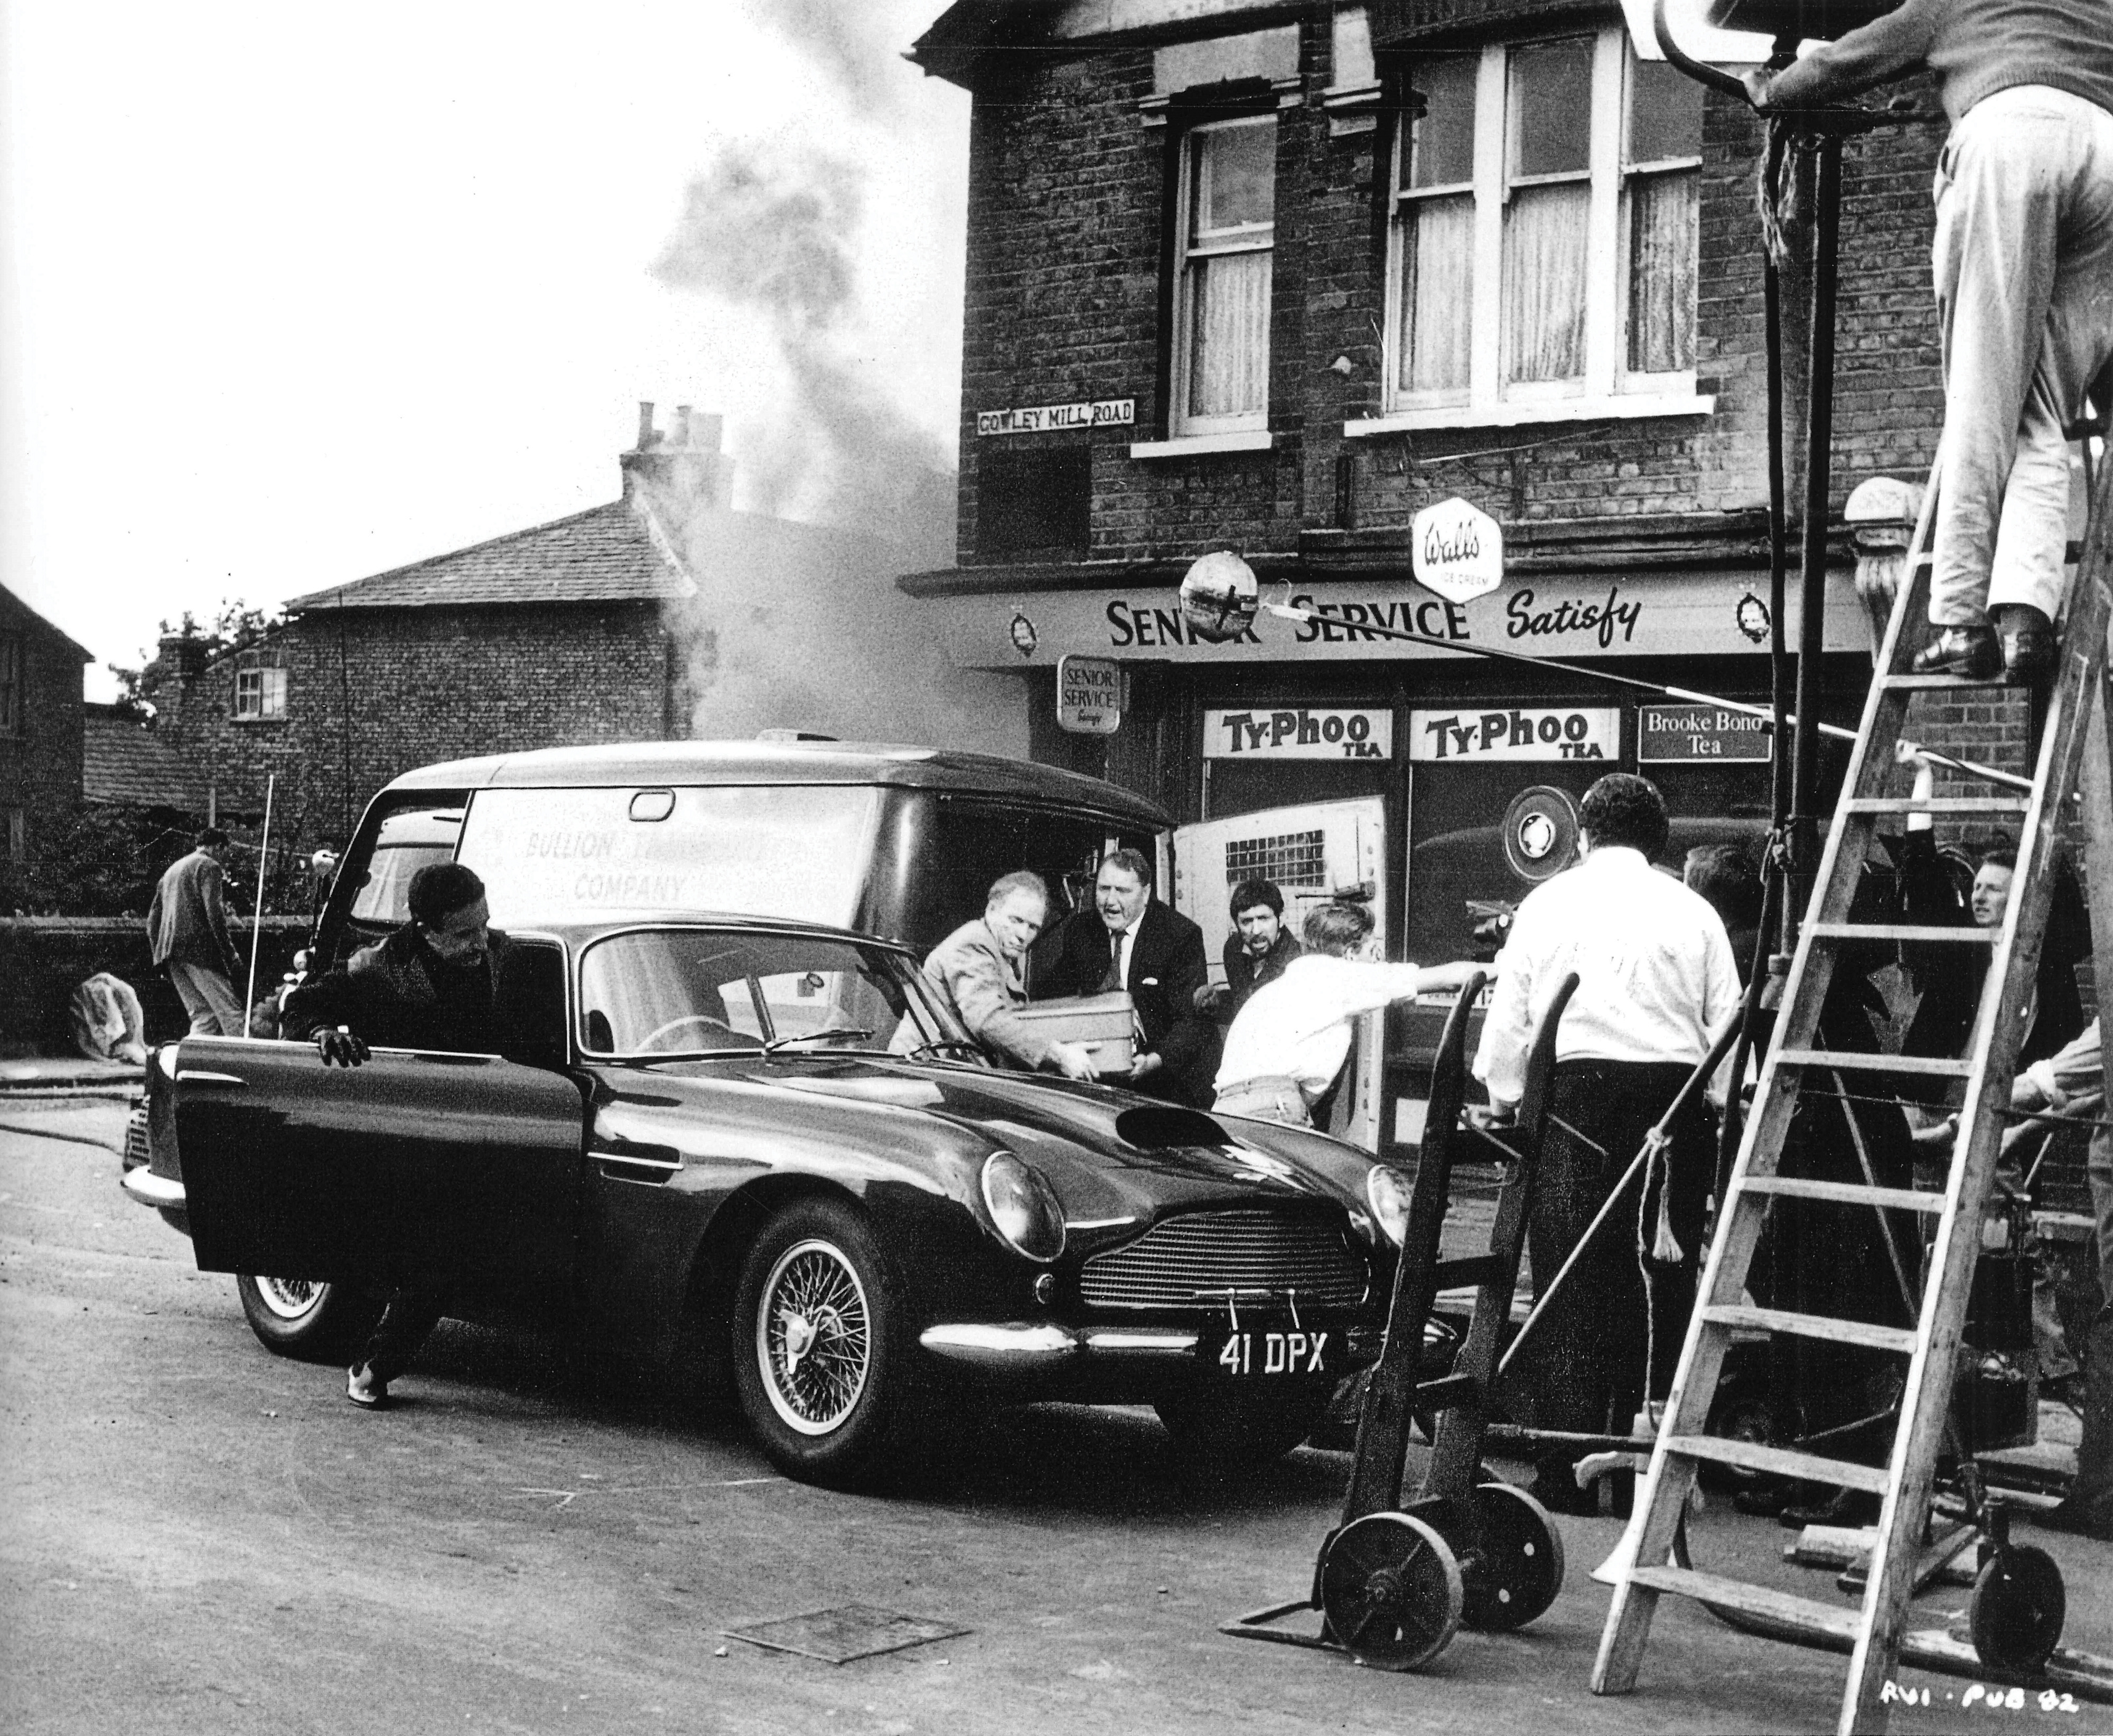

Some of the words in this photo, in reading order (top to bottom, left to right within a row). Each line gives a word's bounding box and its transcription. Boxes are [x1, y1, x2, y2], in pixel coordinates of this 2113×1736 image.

[1048, 406, 1088, 426] MILL
[1093, 402, 1131, 423] ROAD
[1106, 600, 1262, 646] SEN
[1291, 595, 1471, 642] SERVICE
[1507, 586, 1642, 649] Satisfy
[1067, 668, 1114, 686] SENIOR
[1064, 688, 1115, 708] SERVICE
[1648, 713, 1712, 732] Brooke
[1342, 742, 1383, 758] TEA
[1558, 743, 1604, 759] TEA
[1687, 734, 1722, 754] Tea
[526, 832, 616, 860] BULLION
[574, 873, 687, 901] COMPANY
[1219, 1333, 1251, 1375] 41
[1265, 1332, 1328, 1374] DPX
